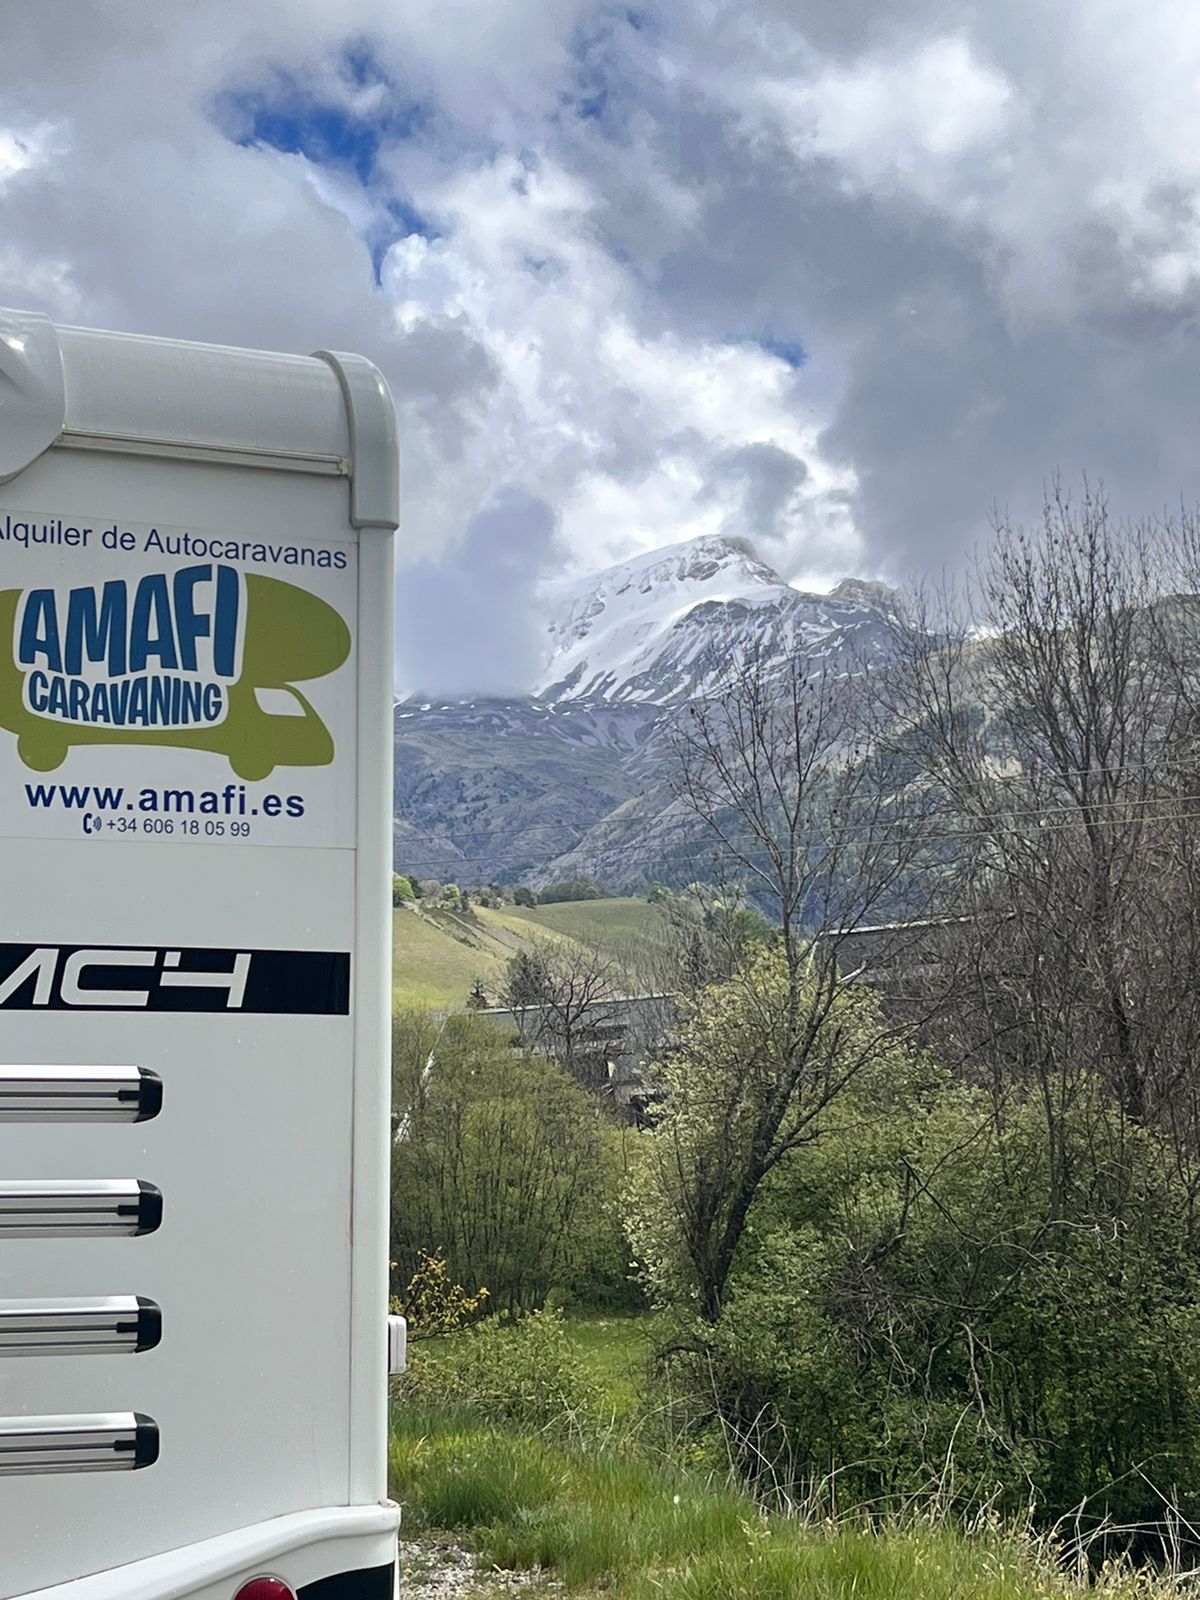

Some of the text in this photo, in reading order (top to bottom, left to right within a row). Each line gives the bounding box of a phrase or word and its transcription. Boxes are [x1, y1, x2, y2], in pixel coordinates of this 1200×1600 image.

[0, 516, 348, 569] lquiler de Autocaravanas
[18, 563, 240, 678] AMAFI
[28, 670, 223, 727] CARAVANING
[24, 783, 306, 818] www.amafi.es
[106, 818, 251, 837] +34 606 18 05 99
